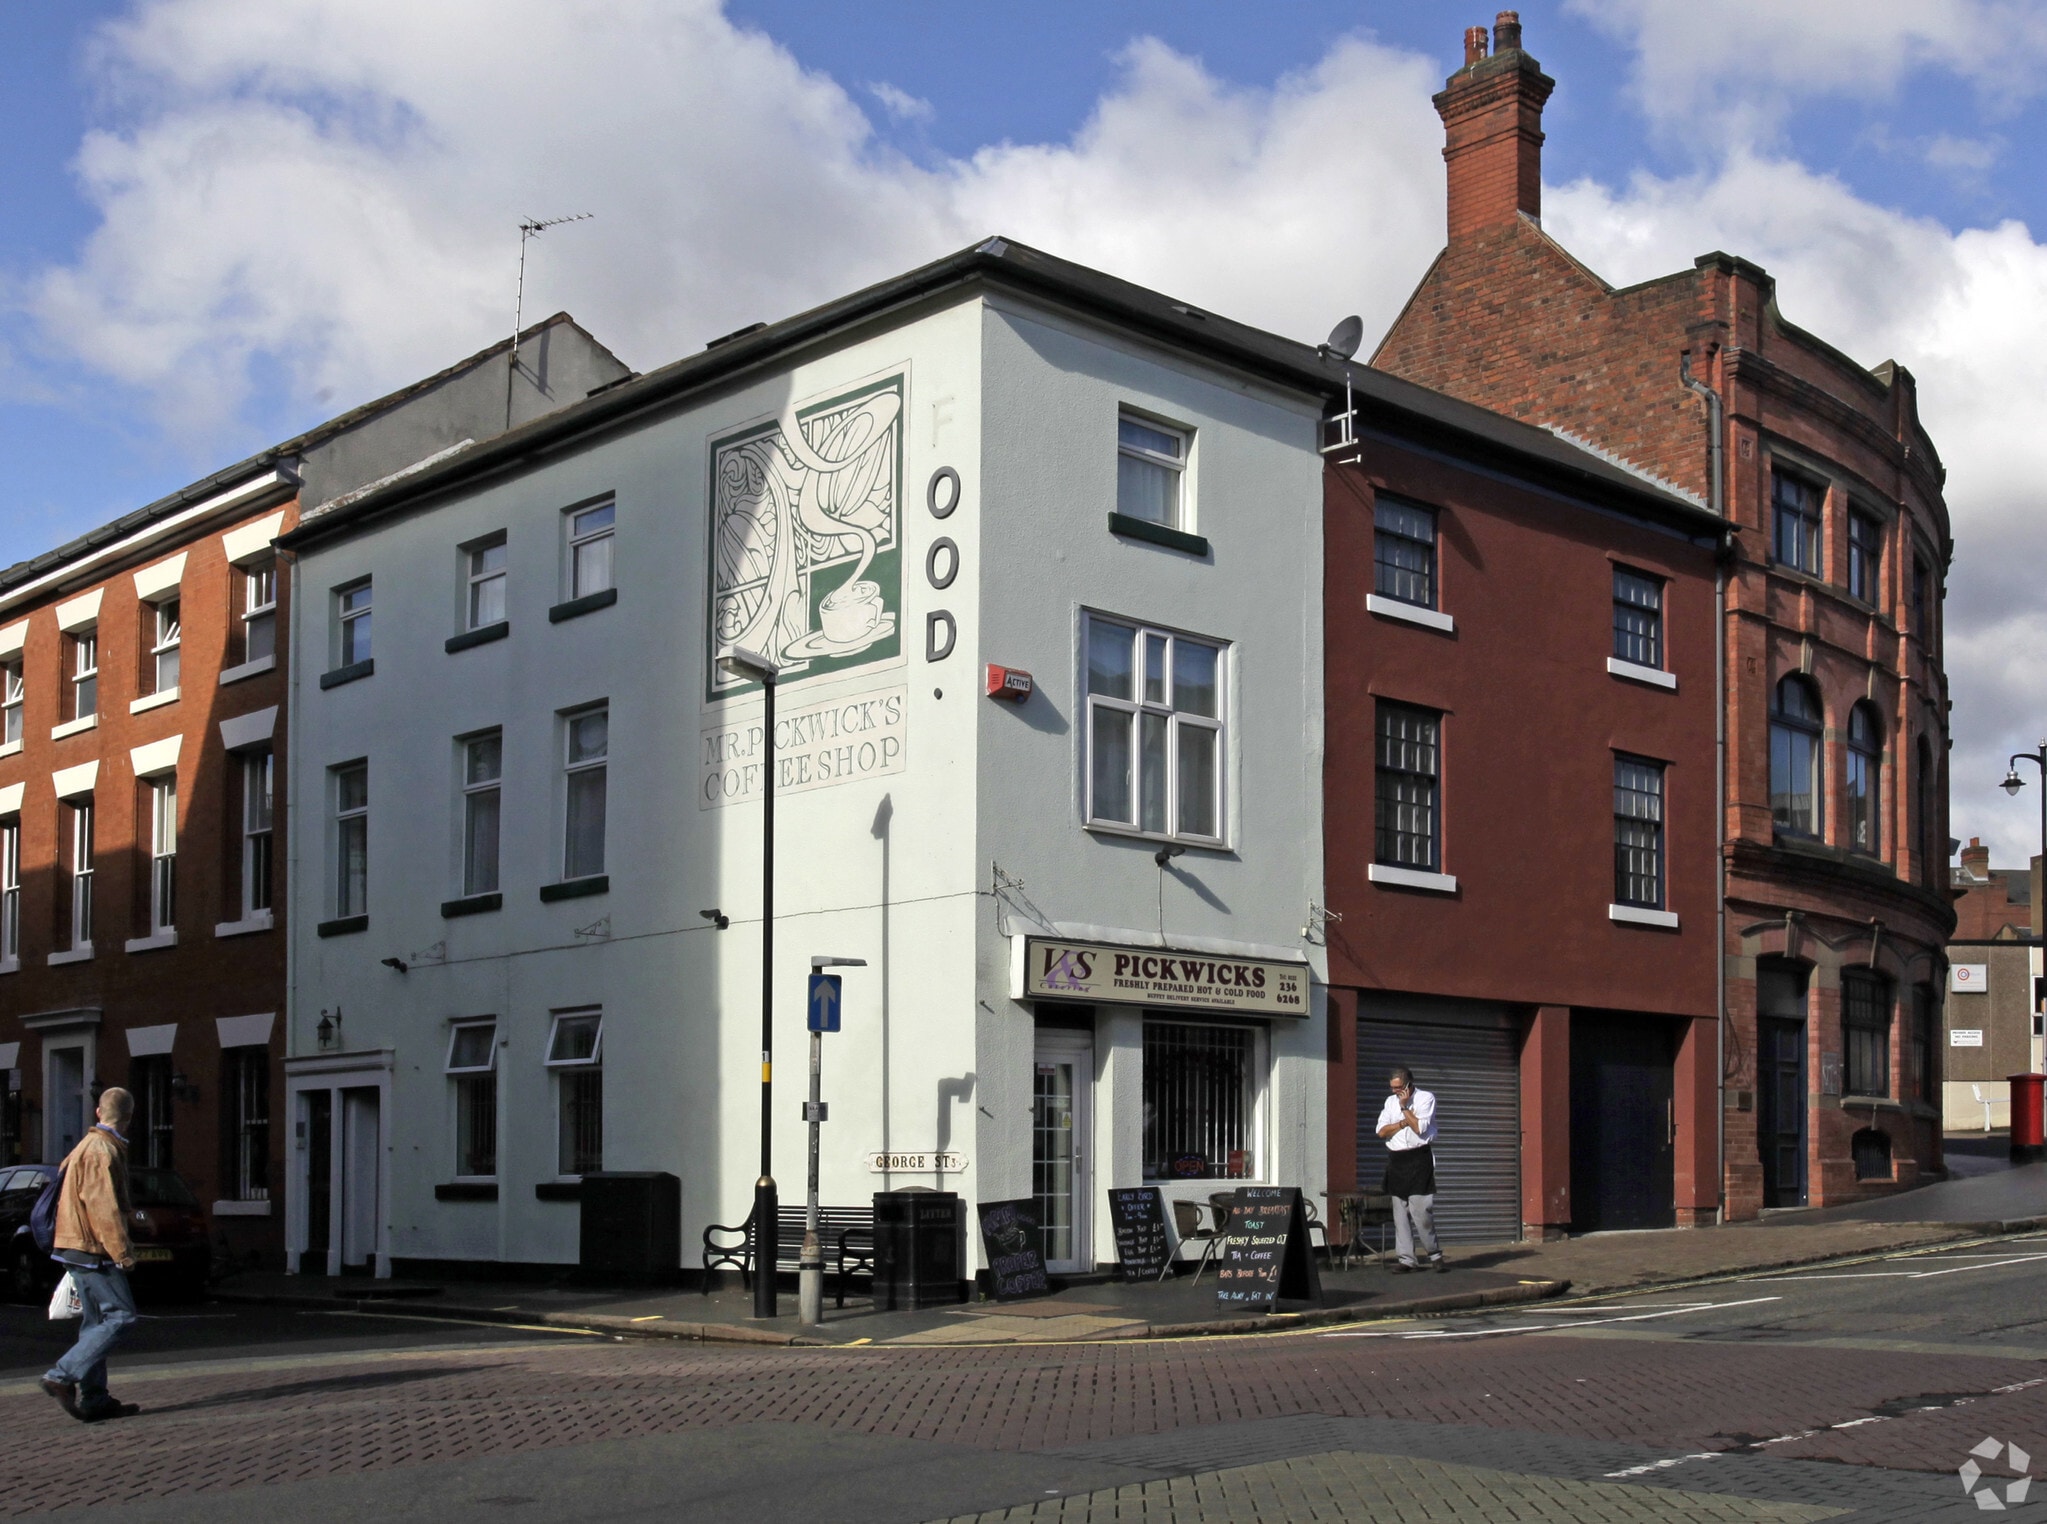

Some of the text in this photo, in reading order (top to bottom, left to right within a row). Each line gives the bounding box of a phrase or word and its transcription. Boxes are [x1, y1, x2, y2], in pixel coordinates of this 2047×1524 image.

[1006, 675, 1030, 689] ACTIVE
[1114, 954, 1265, 988] PICKWICKS
[1114, 979, 1150, 990] FRESHLY
[1153, 983, 1194, 994] PREPARED
[1197, 986, 1213, 996] HOT
[1224, 988, 1244, 997] COLD
[1246, 990, 1266, 999] FOOD
[1279, 981, 1297, 992] 236
[1277, 993, 1300, 1005] 6268
[876, 1155, 925, 1169] GEORGE
[935, 1155, 950, 1169] ST
[1174, 1160, 1205, 1173] OPEN
[1117, 1192, 1135, 1201] EARLY
[1247, 1188, 1281, 1198] WELCOME
[920, 1208, 952, 1219] LITTER
[1259, 1204, 1292, 1216] BREAKFAST
[1244, 1220, 1265, 1230] TOAST
[1226, 1234, 1288, 1247] FRESHLY SQUEEZED OJ
[1231, 1250, 1273, 1261] TEA COFFEE
[992, 1250, 1040, 1278] PROPER
[997, 1271, 1048, 1295] COFFEE
